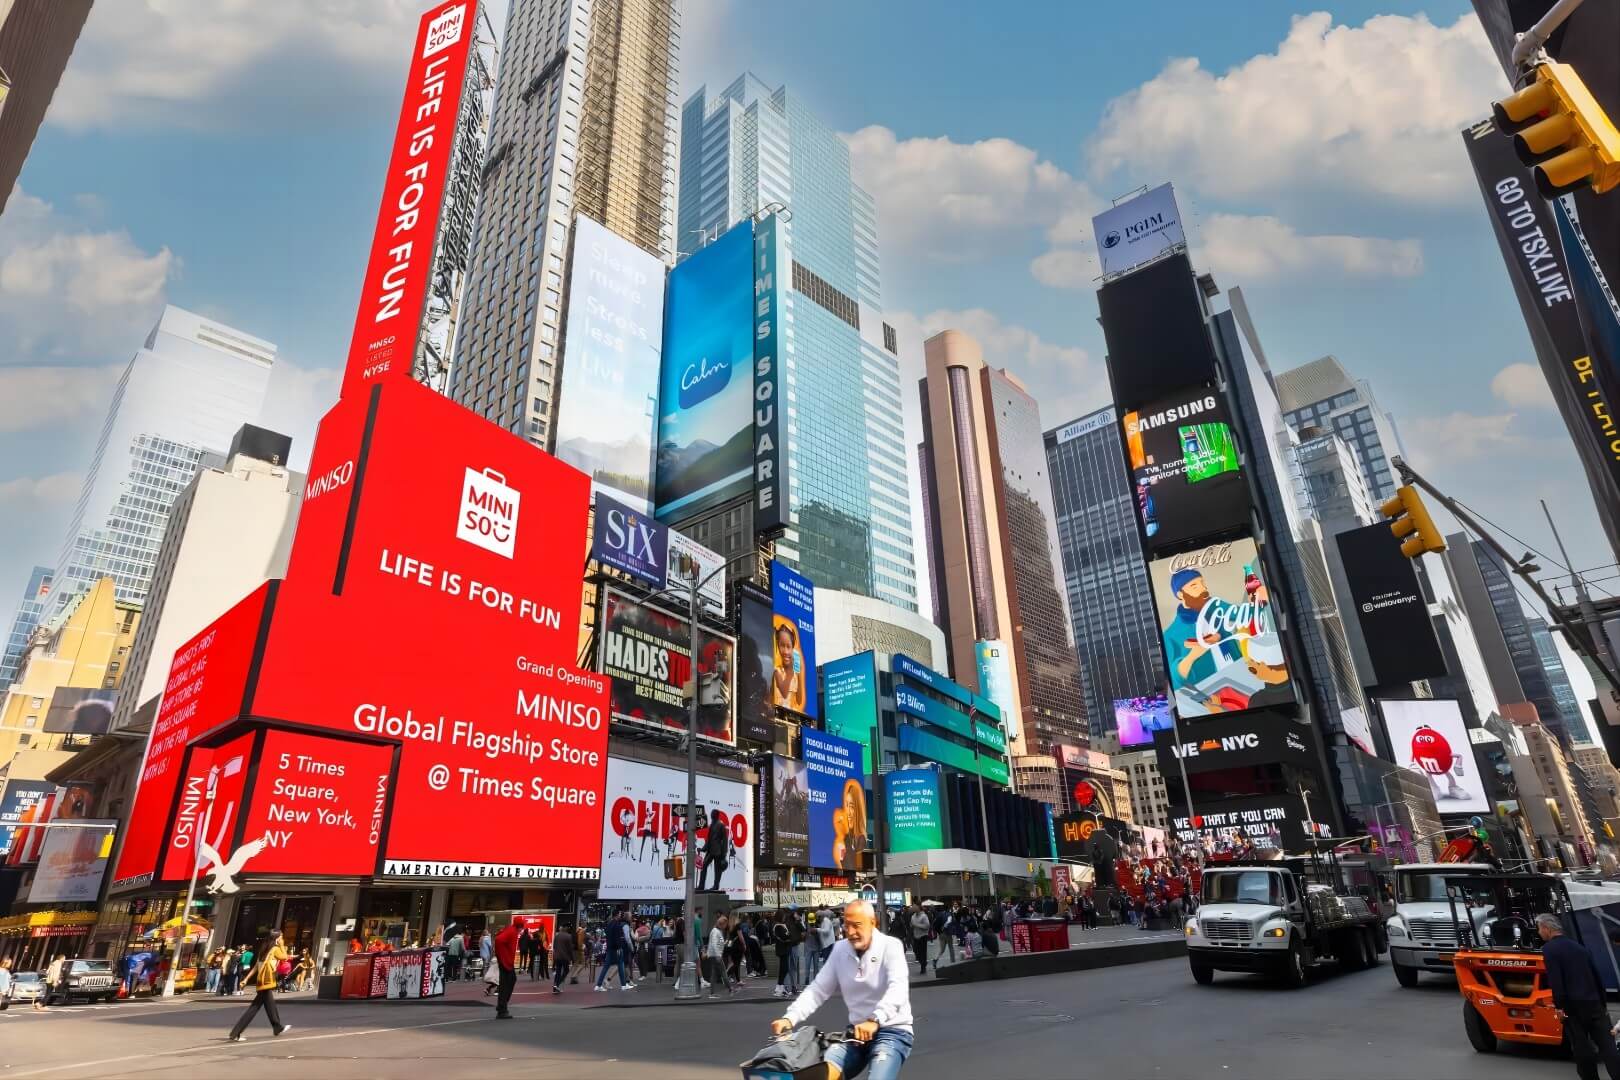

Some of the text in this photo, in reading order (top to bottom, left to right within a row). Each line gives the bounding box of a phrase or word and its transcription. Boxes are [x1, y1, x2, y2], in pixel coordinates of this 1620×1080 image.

[430, 14, 461, 37] MINI
[375, 56, 449, 323] LIFE IS FOR FUN
[1125, 213, 1163, 238] PGIM
[1495, 176, 1573, 308] GO TO TSX.LIVE
[591, 241, 648, 287] Sleep
[586, 294, 649, 341] Stress
[368, 335, 396, 351] MNSO
[363, 360, 391, 379] NYSE
[681, 357, 729, 391] Calm
[755, 229, 774, 510] TIMES SQUARE
[1063, 420, 1097, 438] Allianz
[1127, 395, 1217, 435] SAMSUNG
[1162, 457, 1188, 470] home
[306, 460, 353, 501] MINISO
[468, 485, 513, 521] MINI
[605, 509, 659, 568] SIX
[1168, 543, 1232, 574] Coca-Cola
[379, 549, 561, 631] LIFE IS FOR FUN
[1374, 595, 1417, 609] welovenyc
[516, 656, 603, 694] Grand Opening
[516, 689, 602, 731] MINISO
[635, 684, 684, 708] BEST MUSICAL
[907, 694, 926, 713] Billion
[353, 703, 599, 767] Global Flagship Store
[1171, 733, 1259, 759] WE NYC
[278, 753, 345, 776] 5 Times
[272, 778, 339, 803] Square,
[428, 763, 450, 790] @
[458, 768, 524, 799] Times
[530, 777, 597, 808] Square
[173, 776, 204, 849] MINISO
[268, 804, 357, 830] New York,
[368, 774, 389, 845] MINISO
[1173, 808, 1286, 829] WE THAT IF YOU CAN
[265, 830, 293, 849] NY
[1319, 824, 1332, 838] NYC
[387, 863, 598, 880] AMERICAN EAGLE OUTFITTERS
[1487, 959, 1528, 967] DOOSAN
